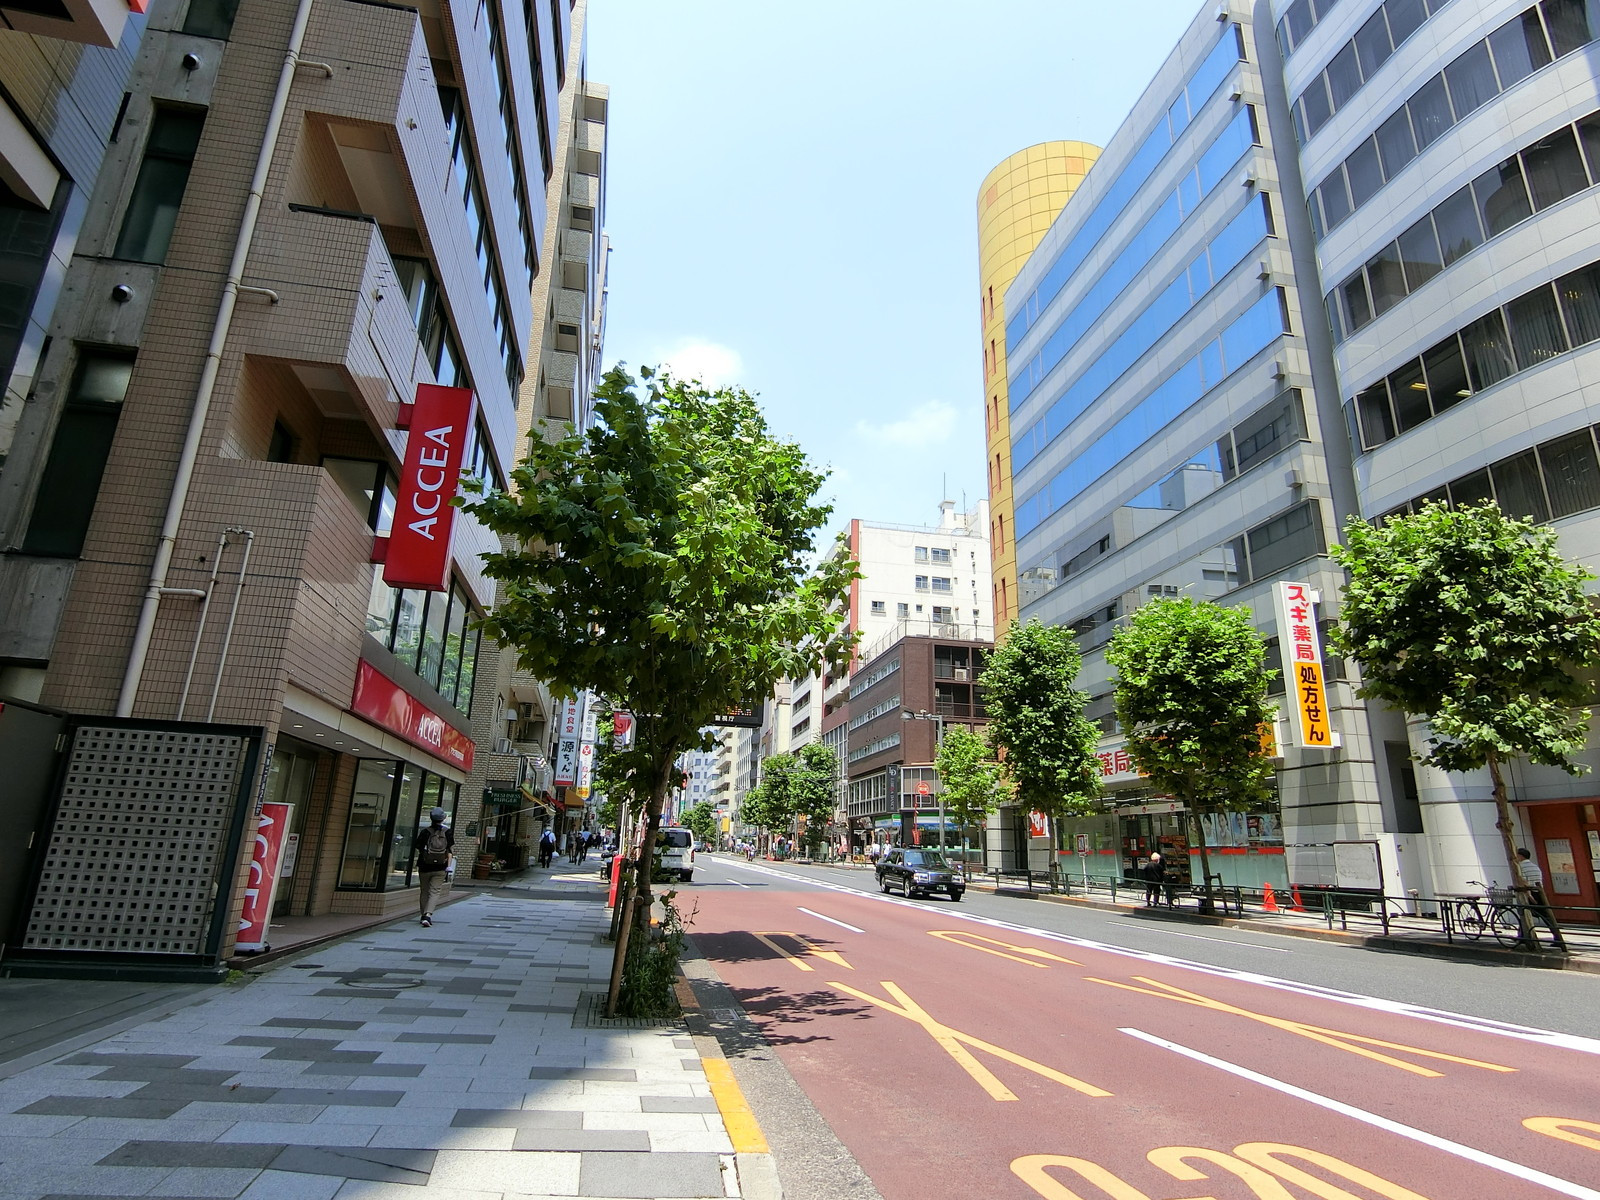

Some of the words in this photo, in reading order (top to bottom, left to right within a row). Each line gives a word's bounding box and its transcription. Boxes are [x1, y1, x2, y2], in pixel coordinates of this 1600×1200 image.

[408, 425, 453, 541] ACCEA
[1287, 585, 1316, 661] スギ薬局
[417, 713, 446, 748] ACCEA
[1300, 665, 1325, 742] 処方せん
[561, 740, 575, 773] 源ちゃん
